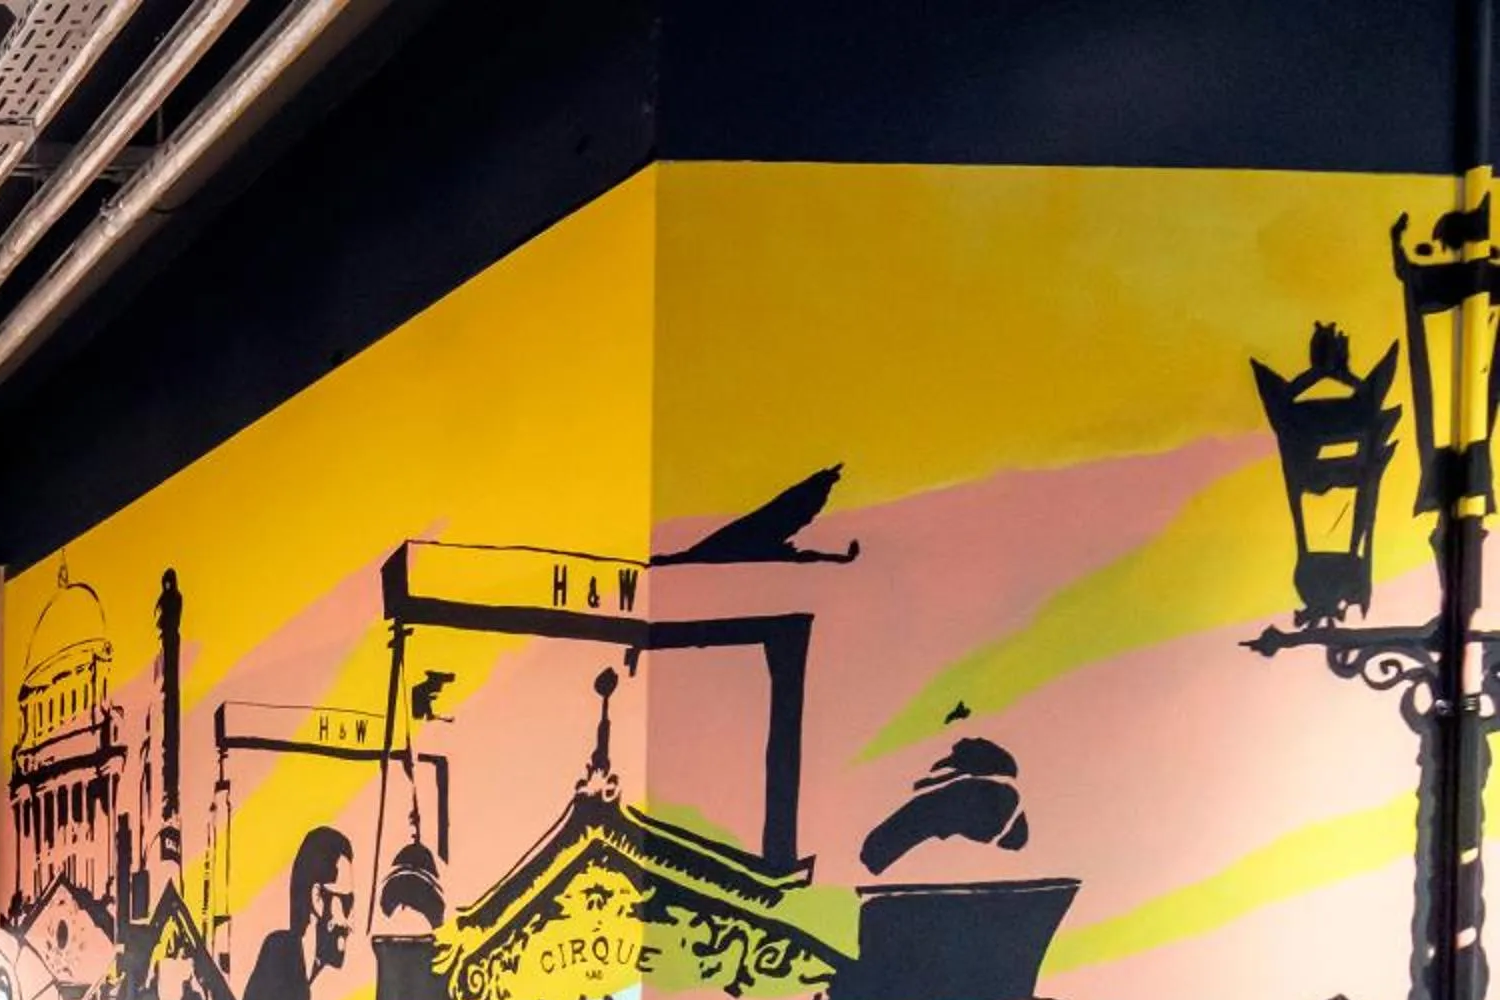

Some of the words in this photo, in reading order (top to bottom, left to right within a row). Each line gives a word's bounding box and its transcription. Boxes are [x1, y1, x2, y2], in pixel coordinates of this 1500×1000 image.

[553, 564, 567, 607] H
[587, 575, 600, 609] &
[618, 567, 638, 612] W
[319, 715, 329, 741] H
[355, 719, 369, 744] W
[540, 935, 663, 974] CIRQUE
